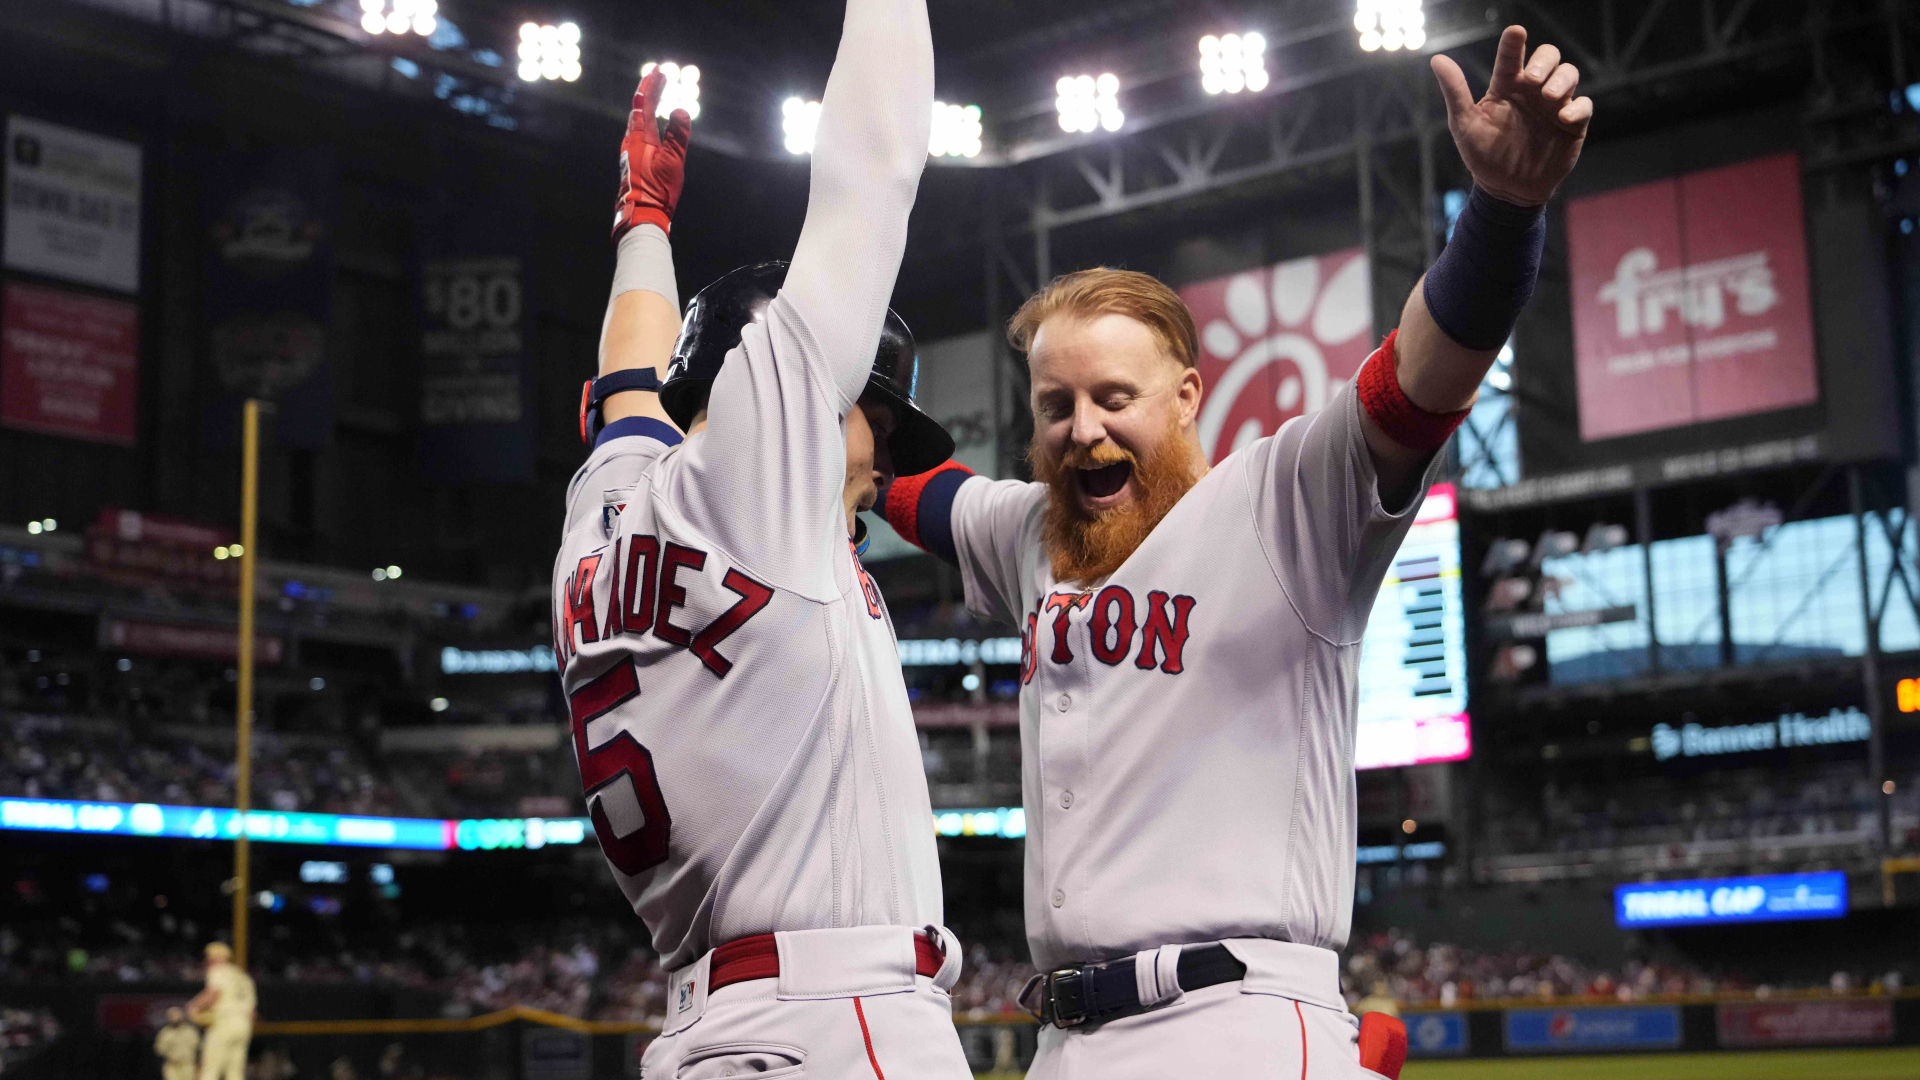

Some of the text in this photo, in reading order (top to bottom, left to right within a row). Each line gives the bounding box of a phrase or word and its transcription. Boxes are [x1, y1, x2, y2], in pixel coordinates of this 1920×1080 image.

[570, 654, 672, 877] 5
[1682, 706, 1871, 757] Banner Health
